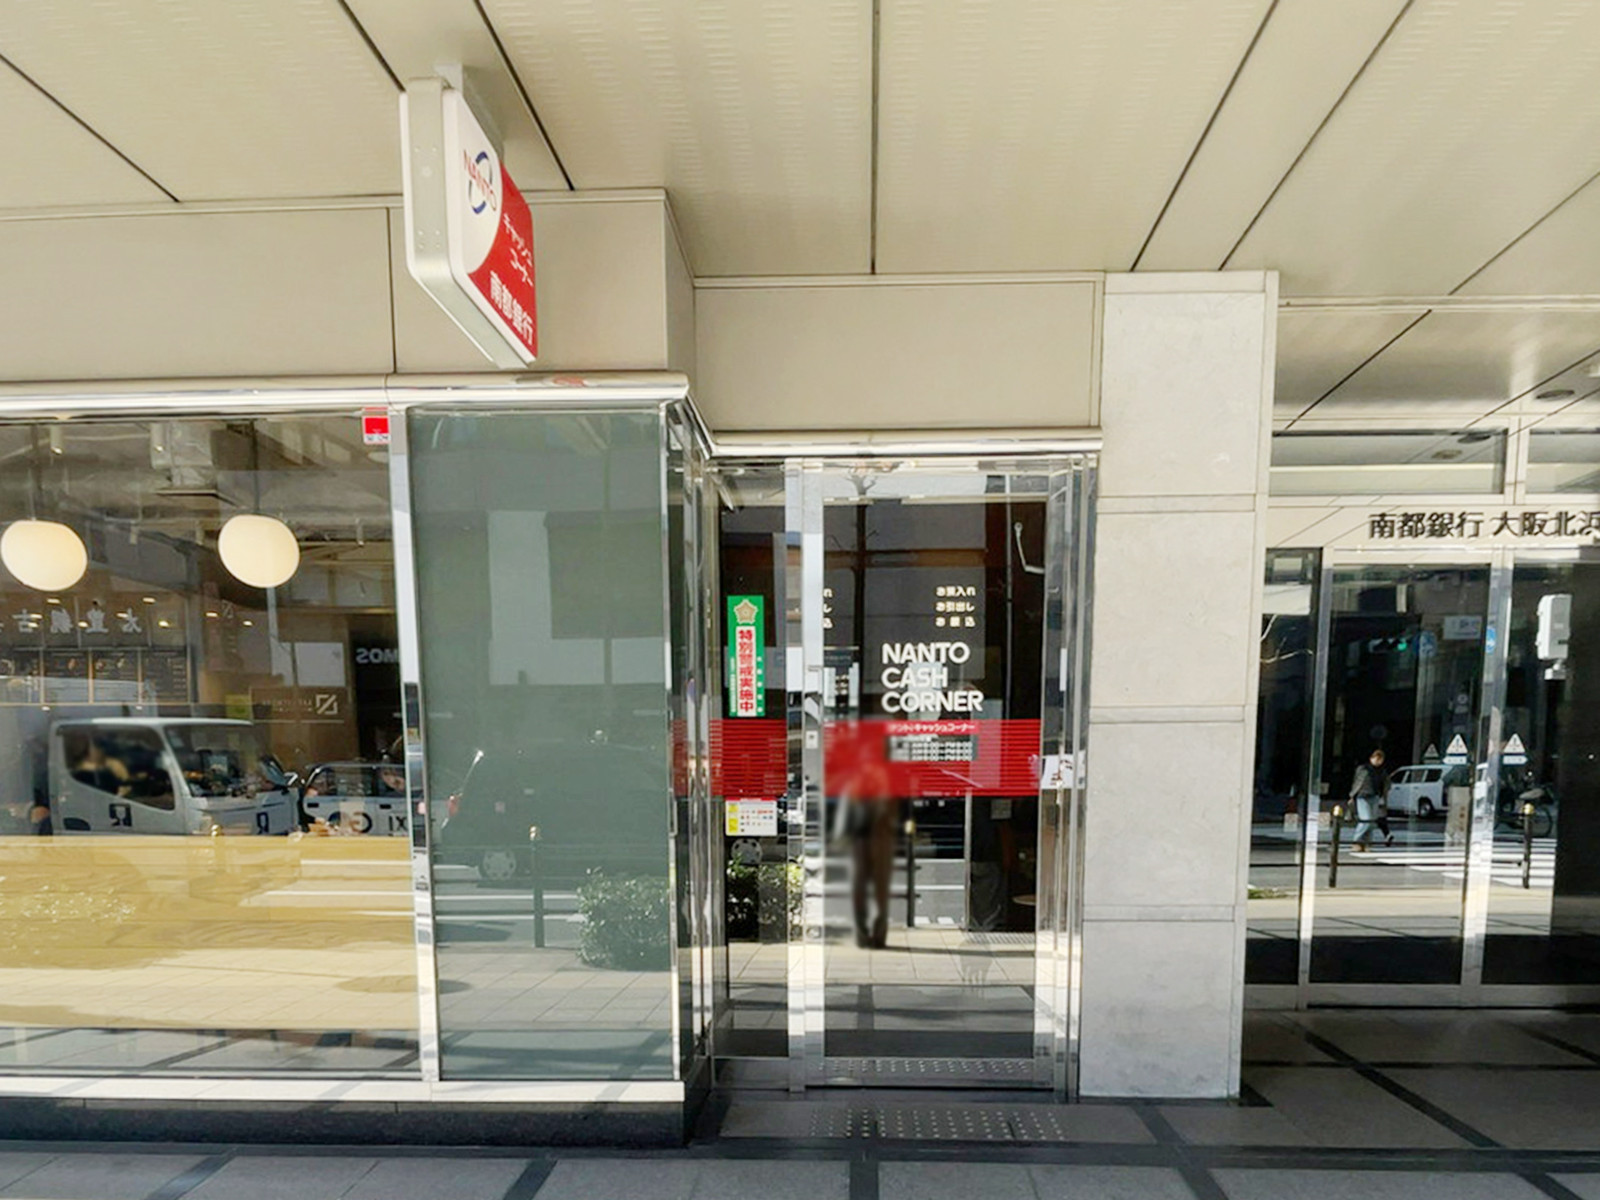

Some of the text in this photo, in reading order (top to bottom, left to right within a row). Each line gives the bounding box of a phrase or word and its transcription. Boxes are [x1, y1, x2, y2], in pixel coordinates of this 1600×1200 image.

[490, 270, 533, 346] 南都銀行
[1369, 511, 1484, 538] 南都銀行
[882, 642, 970, 664] NANTO
[738, 629, 754, 712] 特別警戒実施中
[881, 666, 948, 689] CASH
[881, 690, 984, 713] CORNER
